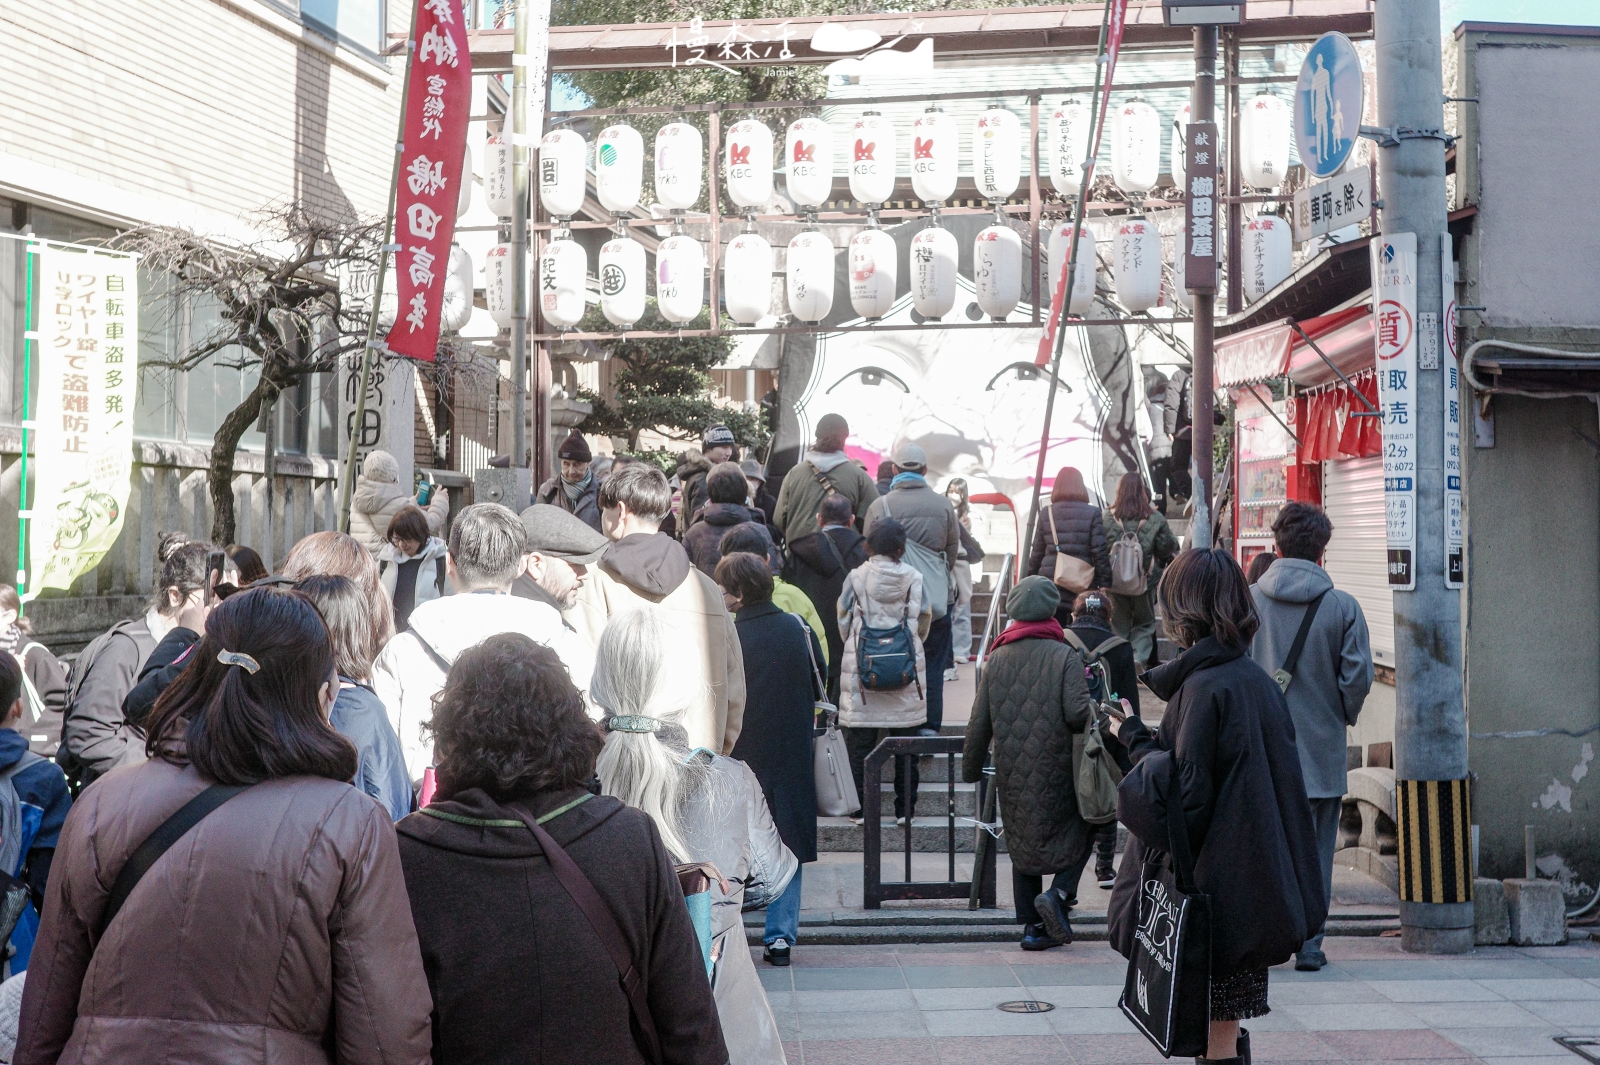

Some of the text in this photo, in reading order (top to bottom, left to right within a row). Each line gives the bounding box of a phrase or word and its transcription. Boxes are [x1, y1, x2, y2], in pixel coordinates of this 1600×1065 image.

[730, 168, 752, 179] KBC
[793, 166, 817, 177] KBC
[853, 164, 877, 176] KBC
[914, 162, 936, 173] KBC
[1190, 132, 1214, 257] 献燈 櫛田茶屋
[1299, 182, 1364, 230] 軽車両を除く
[543, 258, 557, 290] 紀文
[1254, 232, 1265, 294] ホテルオークラ福岡
[76, 274, 98, 352] ワイヤー錠
[1379, 310, 1401, 348] 質
[62, 354, 90, 453] で盗難防止
[1381, 401, 1408, 425] 売
